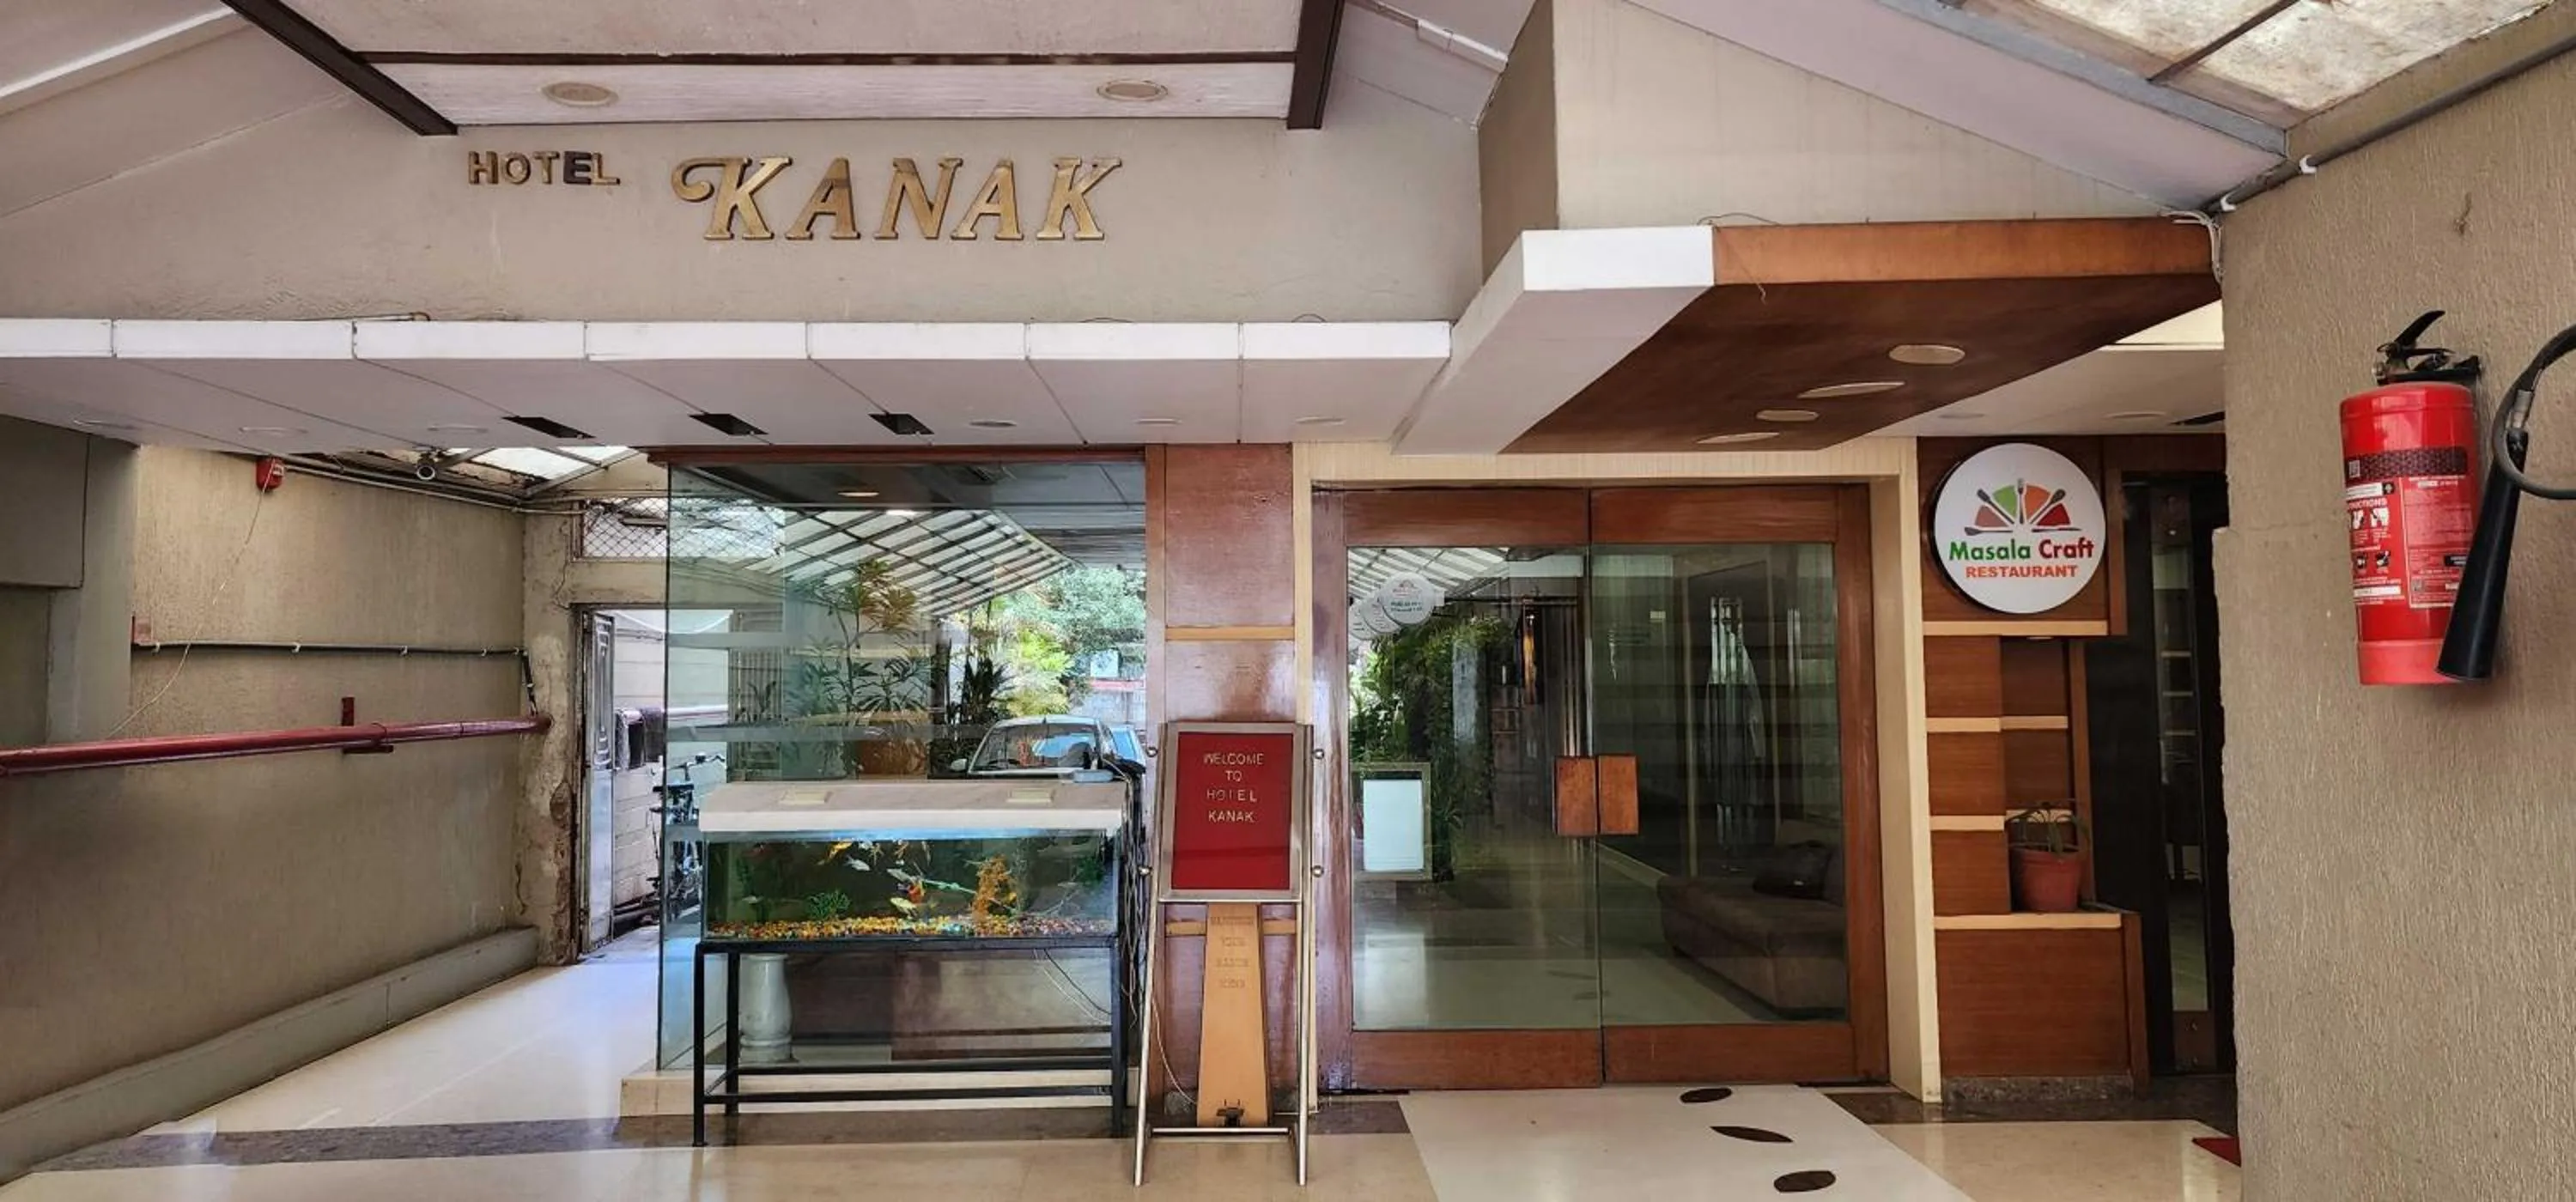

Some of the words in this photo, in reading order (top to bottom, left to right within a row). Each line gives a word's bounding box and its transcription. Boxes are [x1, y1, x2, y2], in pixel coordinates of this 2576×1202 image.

[468, 150, 621, 185] HOTEL
[671, 155, 1123, 241] KANAK
[1948, 538, 2031, 561] Masala
[2038, 536, 2094, 559] Craft
[1965, 564, 2079, 579] RESTAURANT
[1204, 752, 1264, 766] WELCOME
[1225, 769, 1242, 782] TO
[1208, 810, 1255, 823] KANAK
